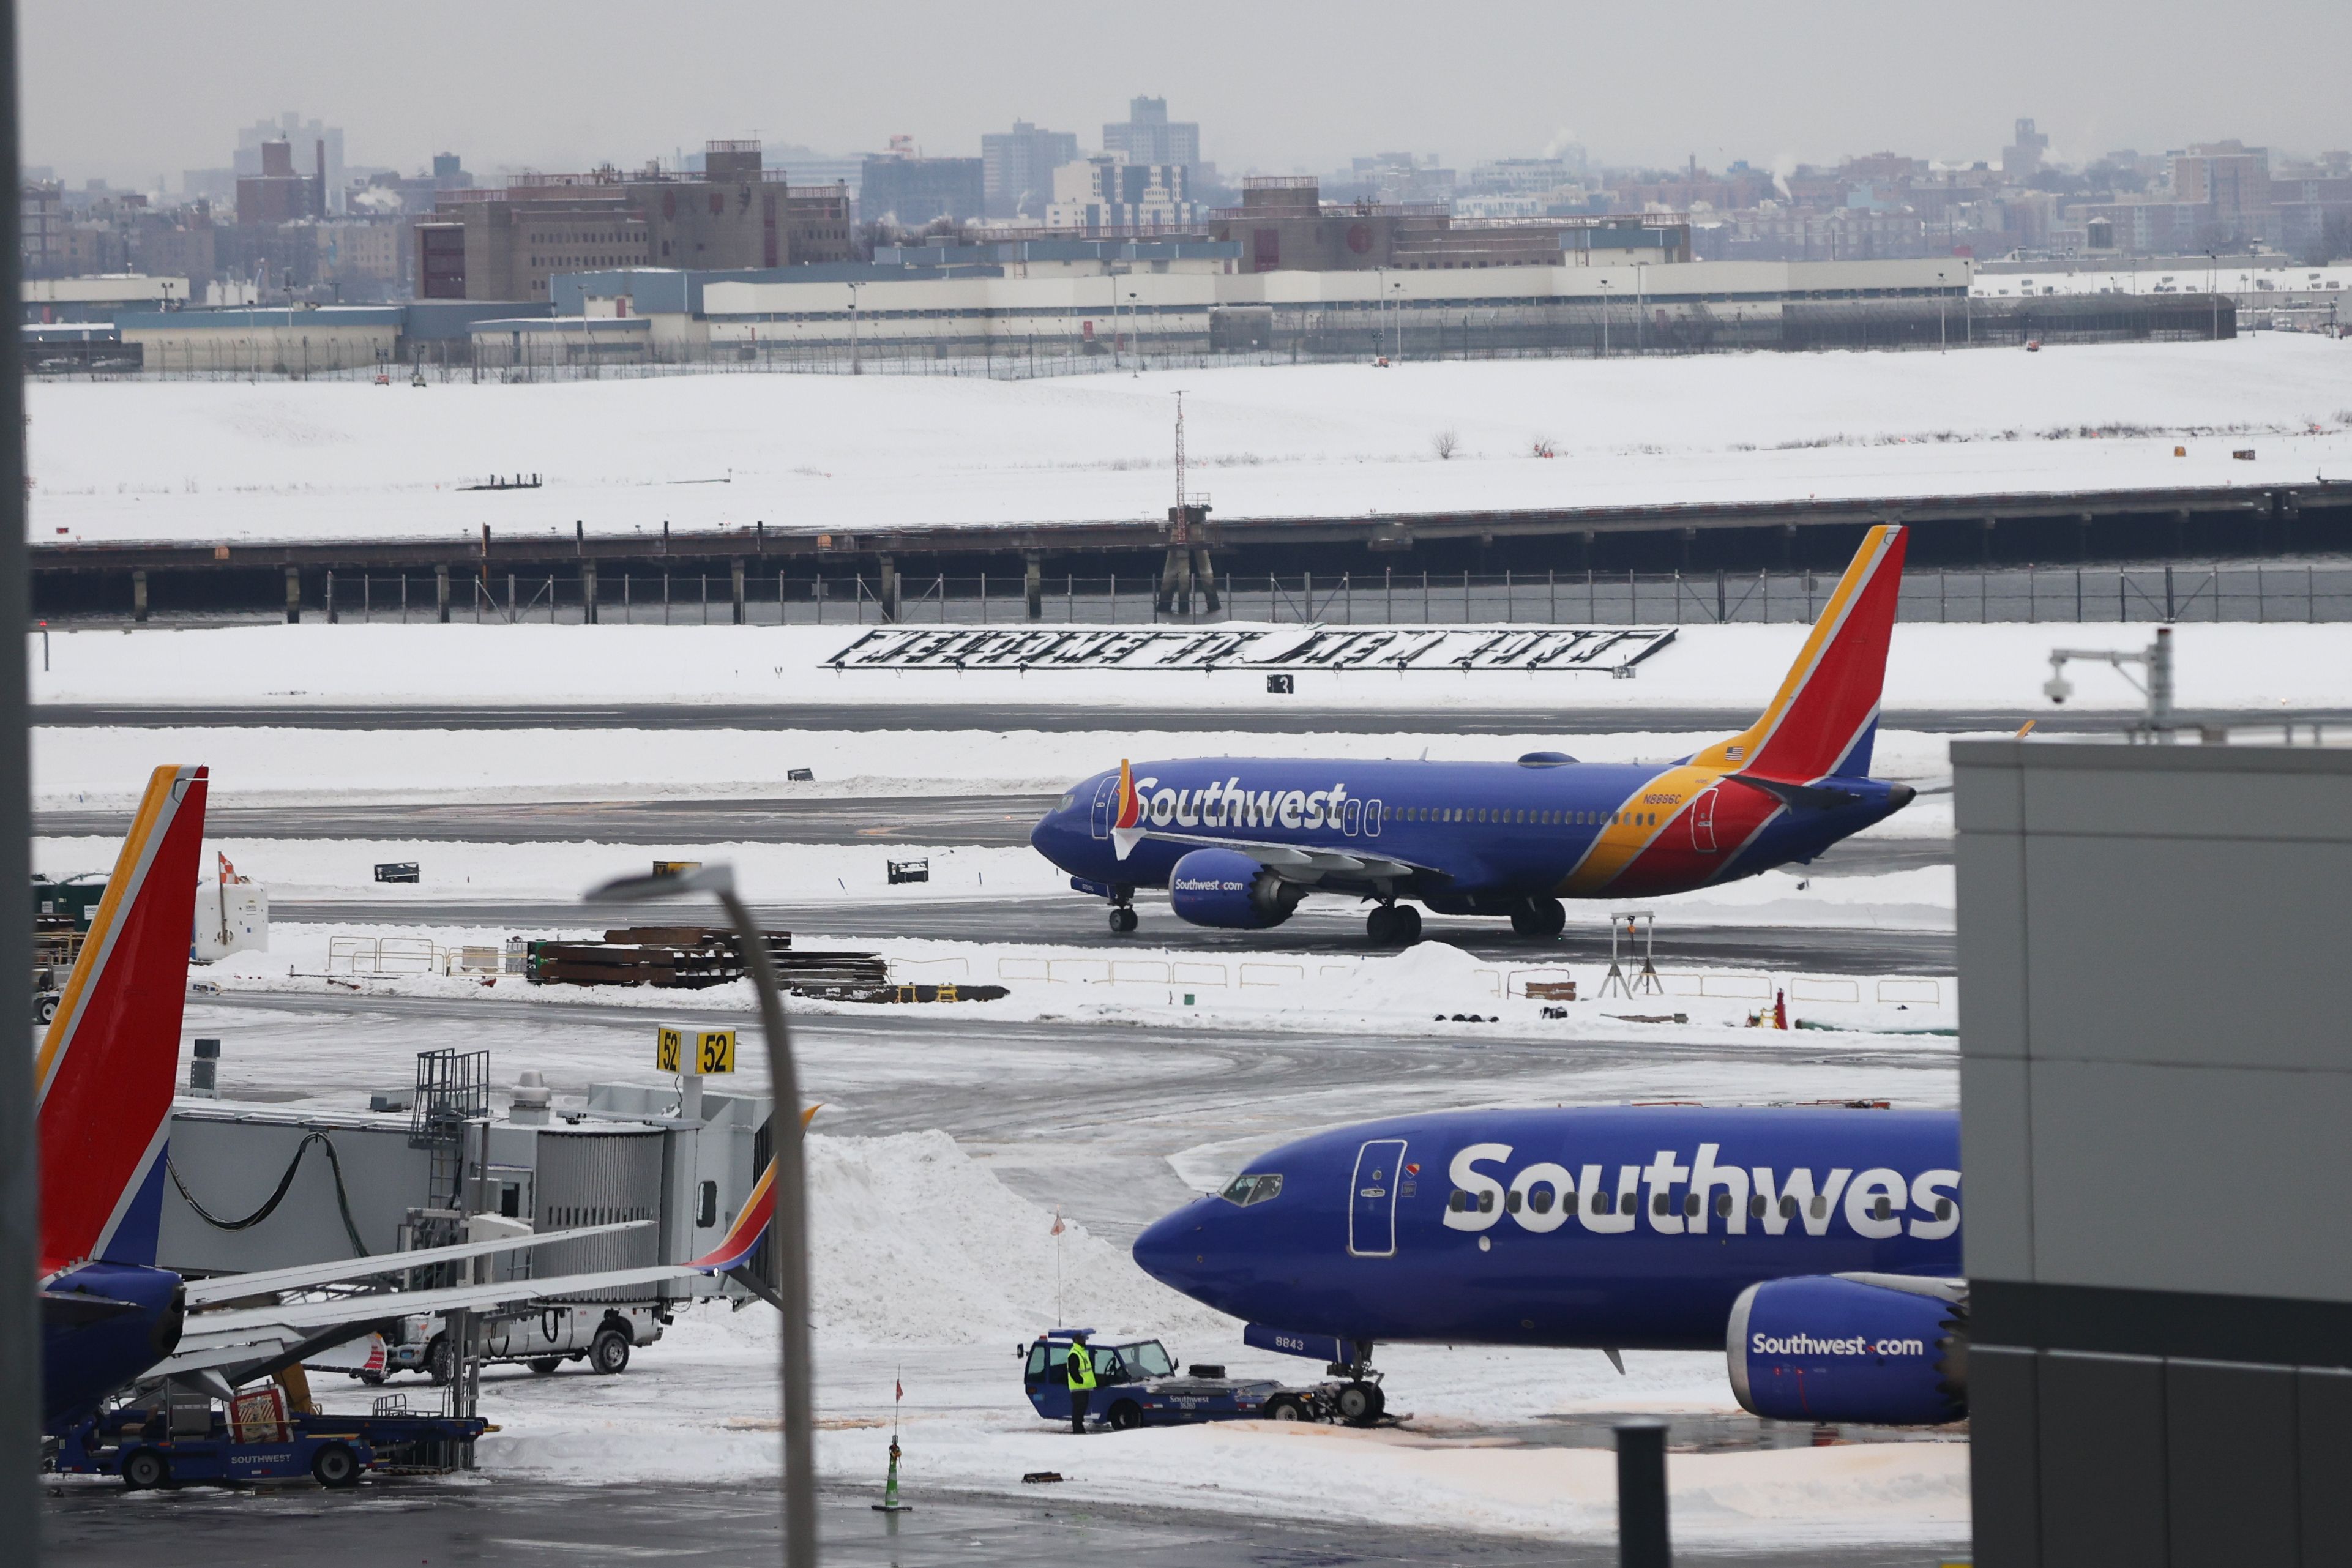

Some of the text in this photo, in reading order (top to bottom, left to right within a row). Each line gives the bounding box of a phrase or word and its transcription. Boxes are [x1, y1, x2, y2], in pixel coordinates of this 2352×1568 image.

[1134, 777, 1347, 829] Southwest
[663, 1031, 678, 1072] 52
[704, 1034, 727, 1072] 52
[1275, 1336, 1304, 1350] 8843
[231, 1454, 292, 1464] SOUTHWEST
